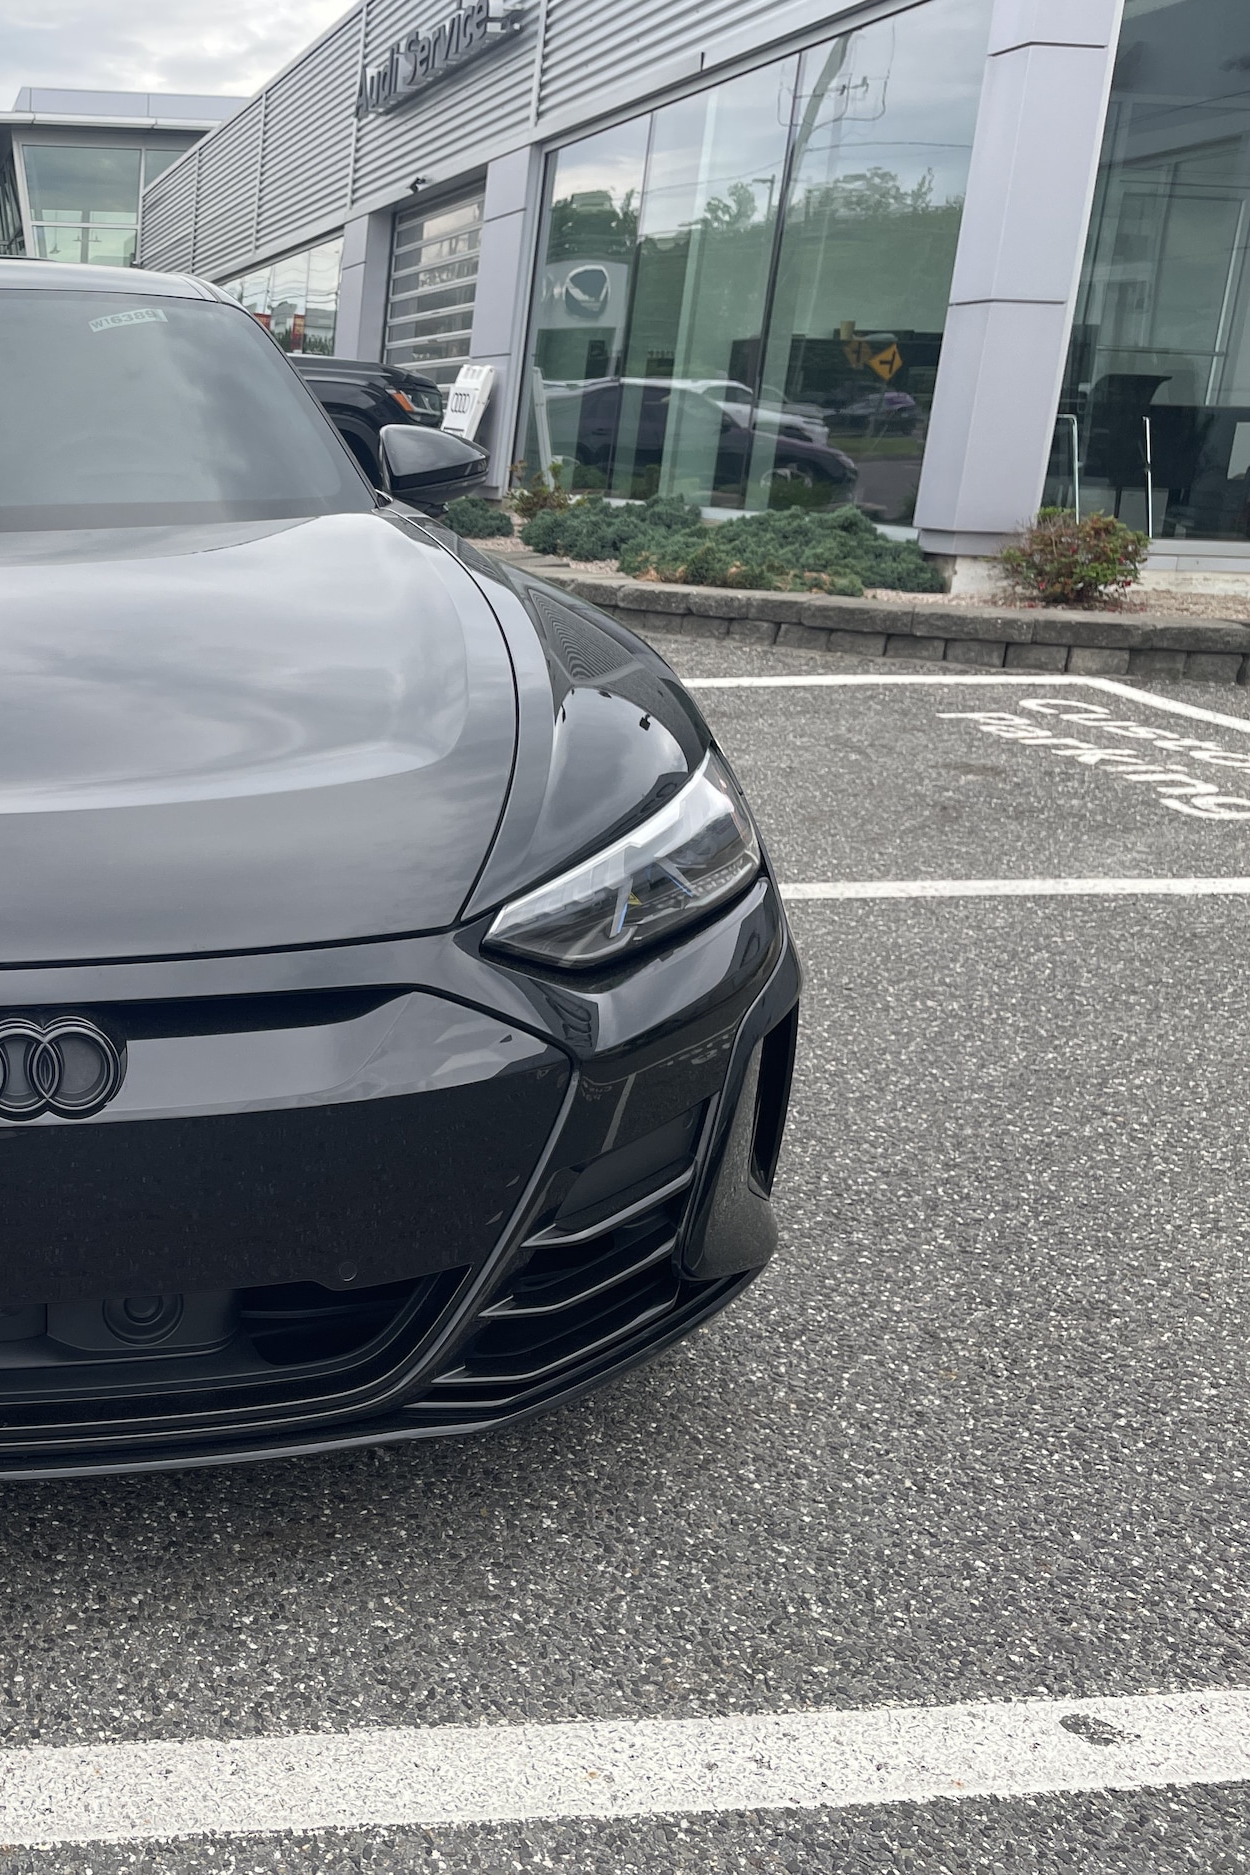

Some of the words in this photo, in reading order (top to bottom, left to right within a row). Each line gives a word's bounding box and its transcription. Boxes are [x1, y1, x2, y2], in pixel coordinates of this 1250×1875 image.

[355, 42, 403, 118] Audi
[405, 0, 490, 87] Service
[91, 309, 157, 329] W16389
[1018, 699, 1250, 775] Custo
